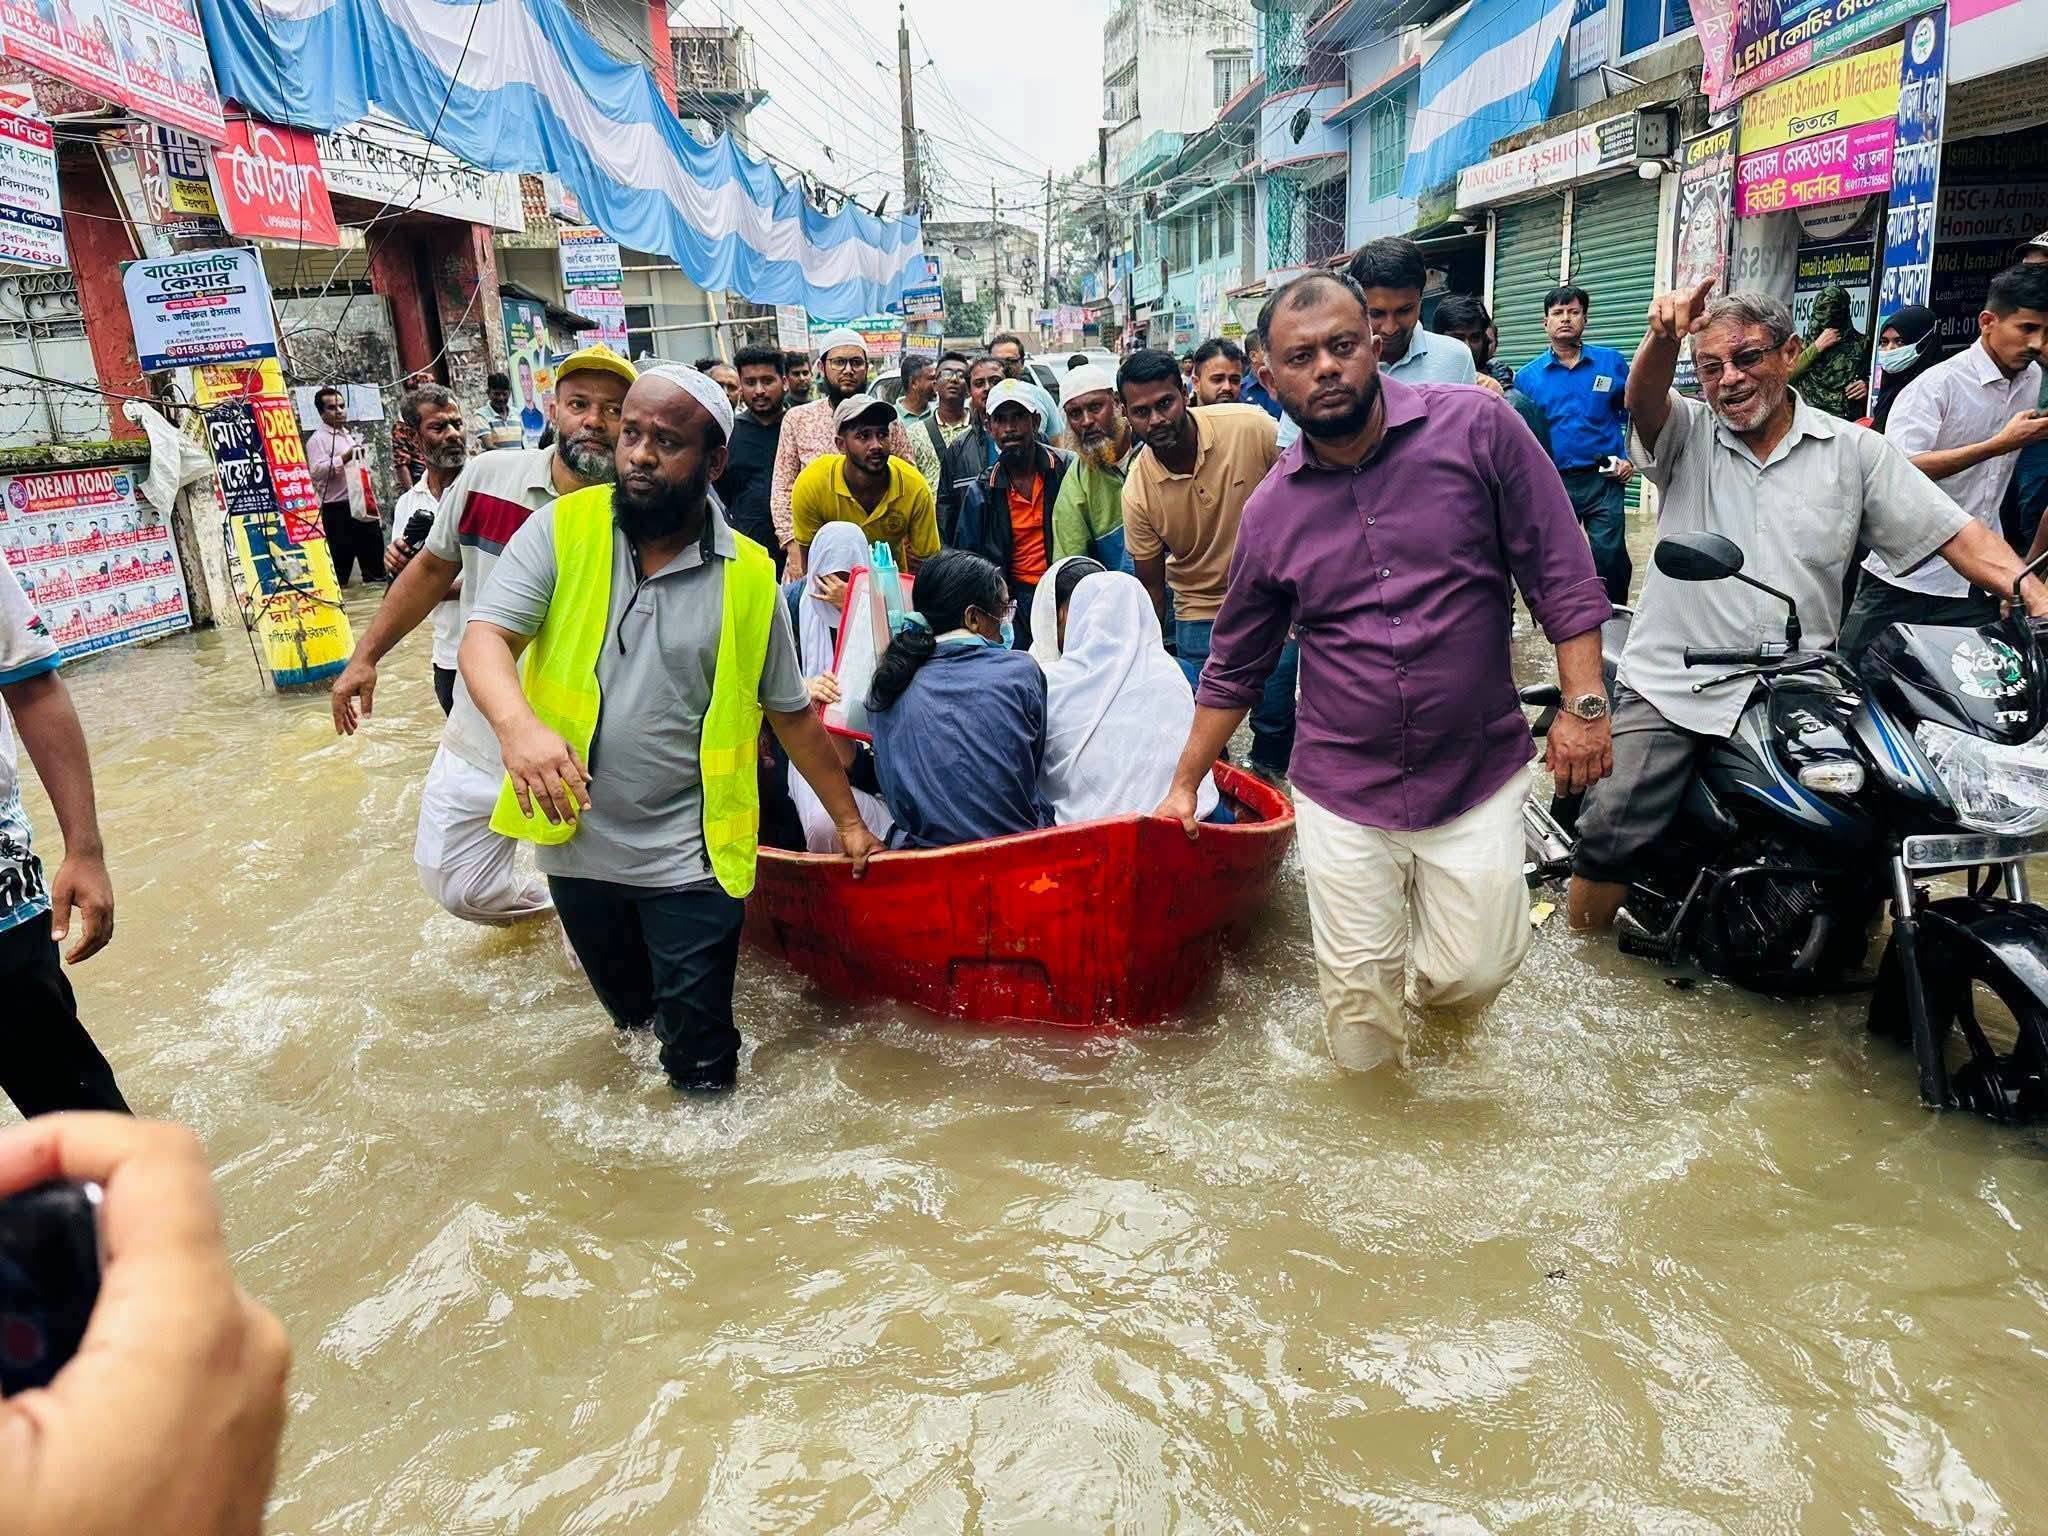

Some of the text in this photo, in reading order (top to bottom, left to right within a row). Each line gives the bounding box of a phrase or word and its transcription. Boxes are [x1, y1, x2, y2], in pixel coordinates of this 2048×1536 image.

[1734, 29, 1779, 76] LENT
[1780, 7, 1831, 50] কোচিং
[1744, 95, 1758, 131] AR
[1759, 86, 1793, 130] English
[1795, 73, 1831, 111] School
[1787, 109, 1840, 137] ভিতরে
[1465, 160, 1513, 190] UNIQUE
[1518, 135, 1591, 174] FASHION
[0, 175, 49, 200] বিদ্যালয়)
[1745, 178, 1786, 212] বিউটি
[1791, 172, 1841, 202] পার্লার
[0, 244, 62, 265] 272639
[142, 255, 239, 280] বায়োলজি
[1822, 253, 1844, 279] English
[1844, 250, 1870, 273] Domain
[161, 271, 231, 293] কেয়ার
[25, 470, 114, 501] DREAM ROAD
[1994, 710, 2028, 724] TVS
